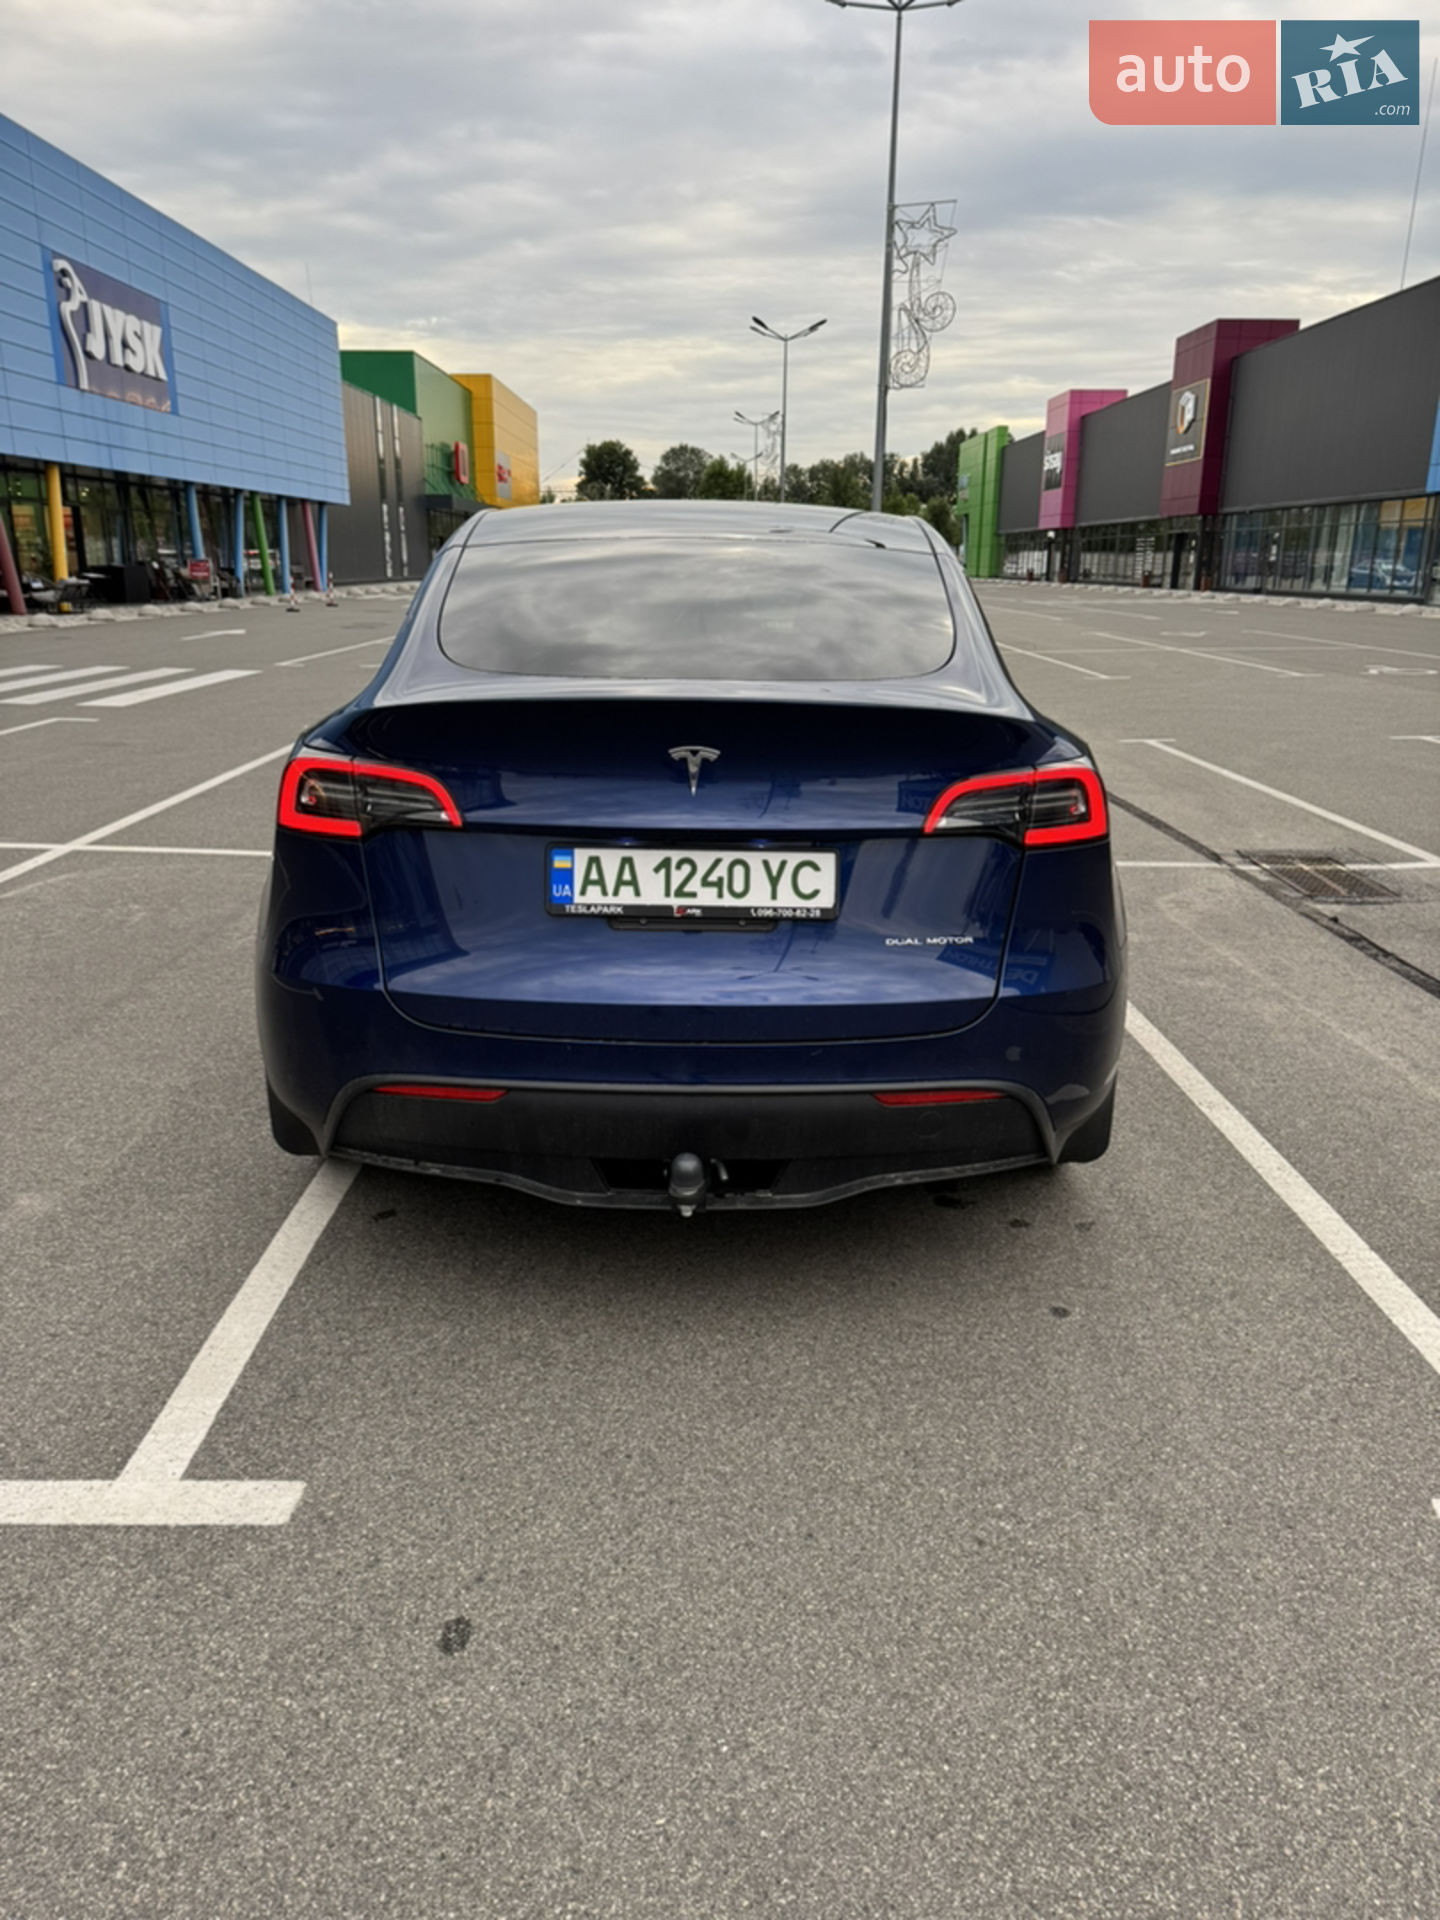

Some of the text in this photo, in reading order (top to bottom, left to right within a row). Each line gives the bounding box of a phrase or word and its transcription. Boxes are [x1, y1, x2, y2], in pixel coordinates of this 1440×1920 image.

[84, 299, 169, 382] JYSK
[579, 855, 822, 901] AA 1240 YC
[552, 883, 573, 898] UA
[564, 904, 624, 915] TESLAPARK
[885, 936, 974, 946] DUAL MOTOR
